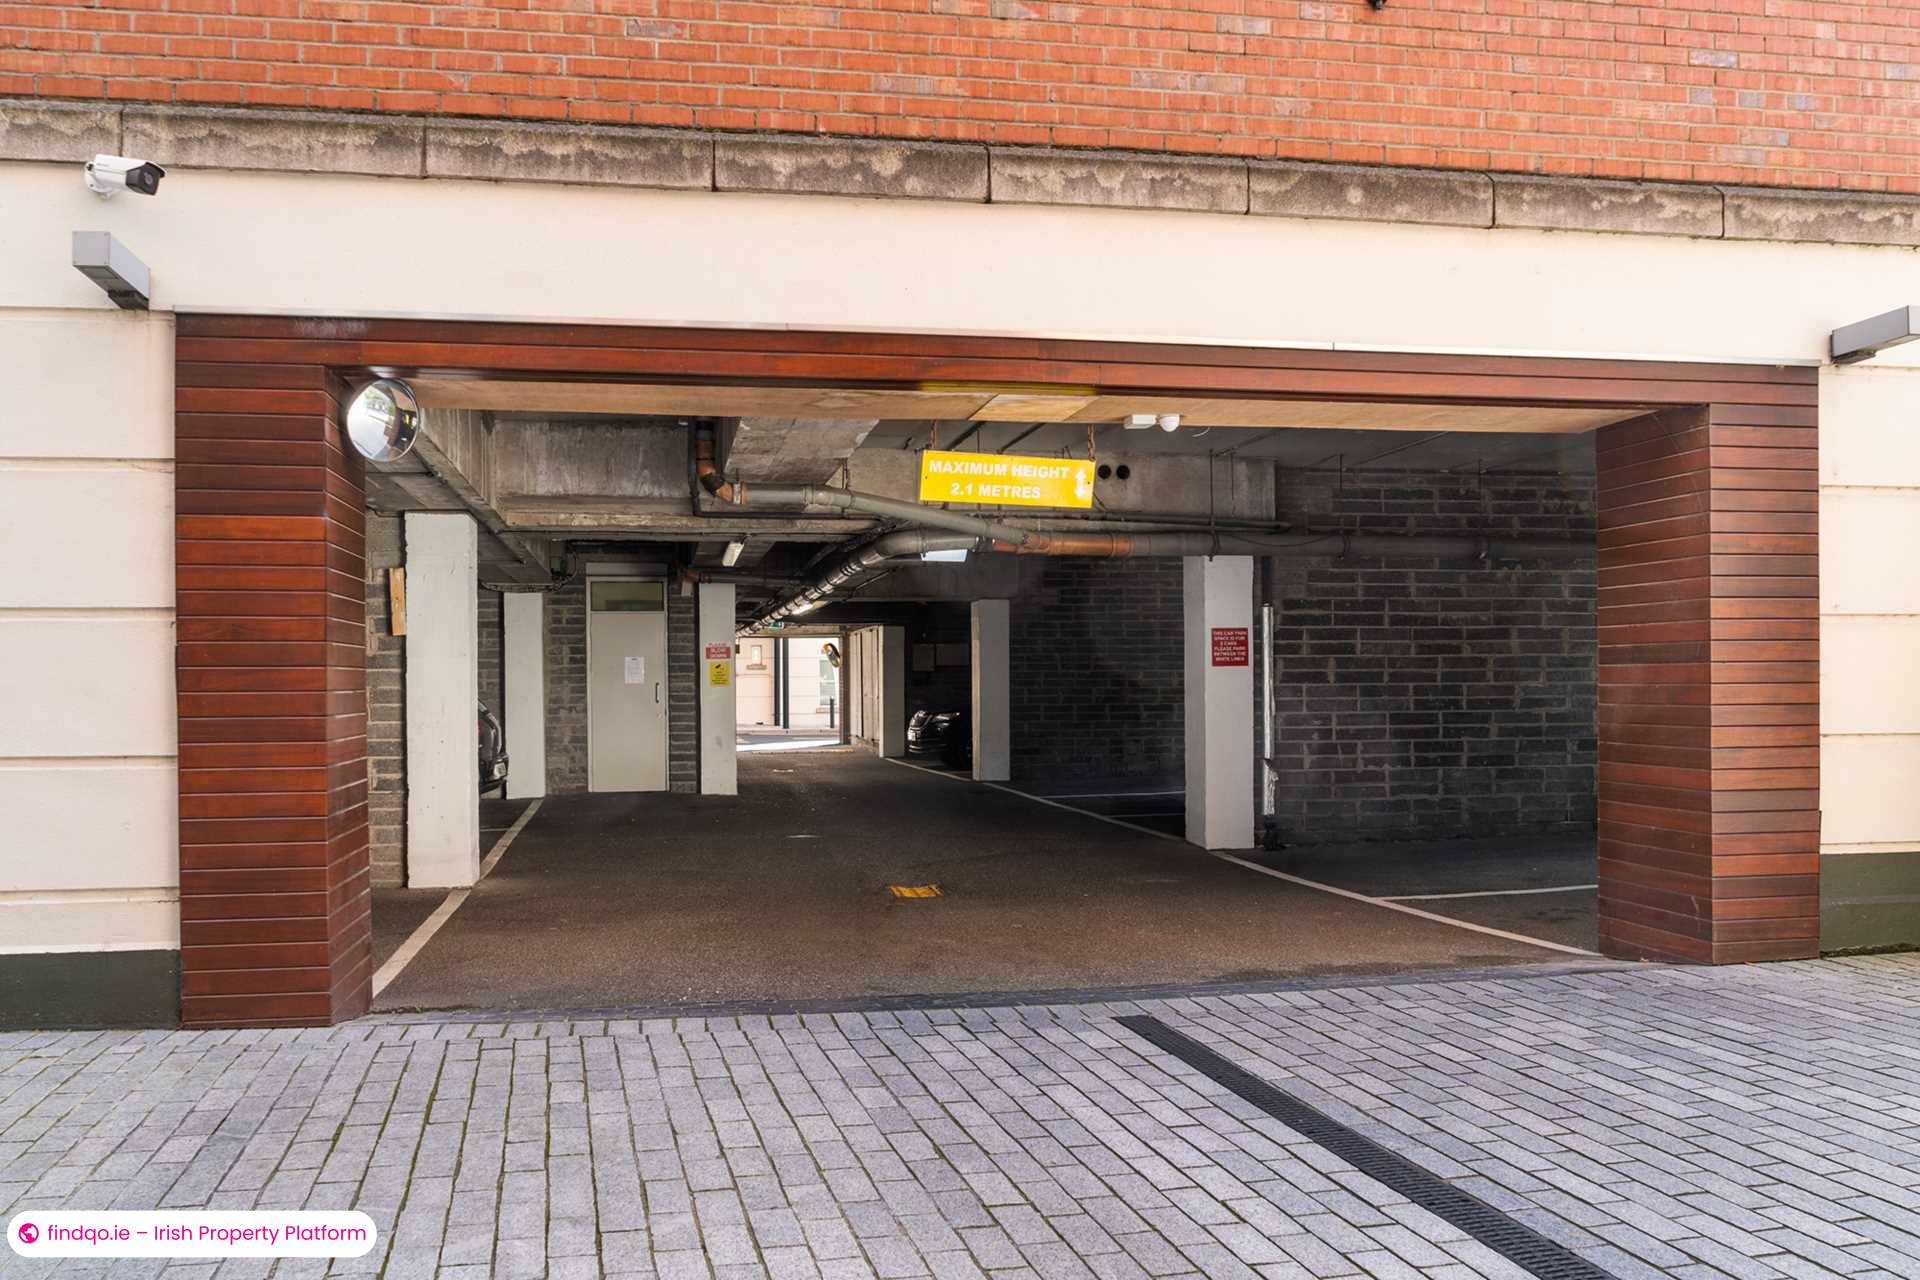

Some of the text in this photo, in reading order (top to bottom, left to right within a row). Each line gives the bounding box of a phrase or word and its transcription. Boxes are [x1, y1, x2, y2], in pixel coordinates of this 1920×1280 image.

[929, 459, 1070, 479] MAXIMUM HEIGHT
[951, 482, 1041, 499] 2.1 METRES
